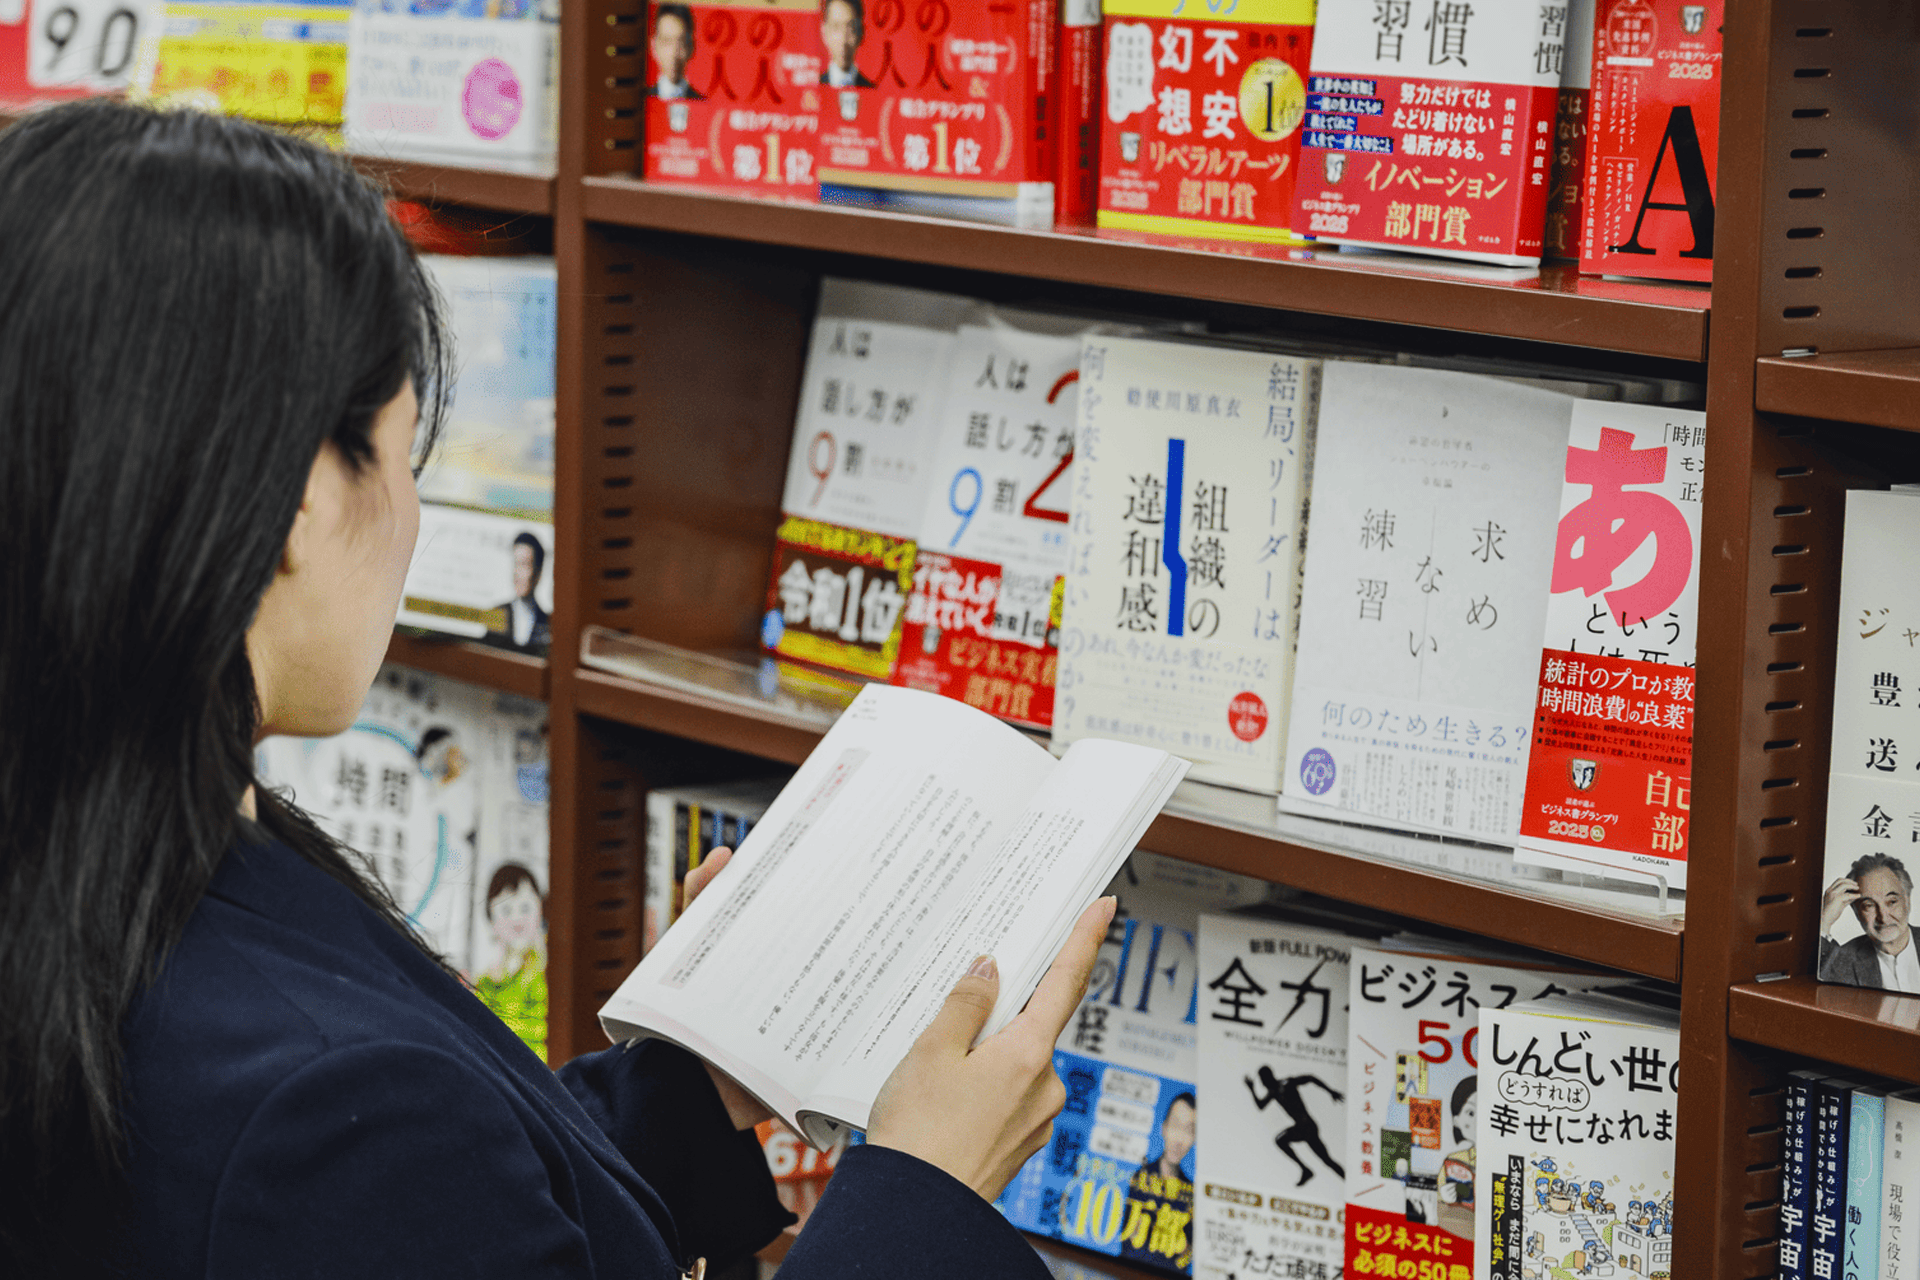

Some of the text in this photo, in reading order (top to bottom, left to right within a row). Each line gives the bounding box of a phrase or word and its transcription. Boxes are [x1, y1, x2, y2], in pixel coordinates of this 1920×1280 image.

[1372, 0, 1475, 67] 習慣
[1532, 6, 1566, 75] 習慣
[1157, 24, 1193, 136] 幻想
[1203, 29, 1240, 140] 不安
[1400, 82, 1491, 109] 努力だけでは
[1392, 107, 1495, 134] たどり着けない
[903, 121, 982, 174] 第1位
[1150, 140, 1290, 181] リベラルアーツ
[1401, 133, 1484, 162] 場所がある。
[1178, 177, 1258, 220] 部門賞
[1364, 160, 1508, 201] イノベーション
[1384, 200, 1471, 246] 部門賞
[975, 353, 1030, 393] 人は
[1253, 361, 1300, 641] 結局、リーダーは
[1550, 426, 1693, 627] あ
[1117, 472, 1166, 633] 違和感
[1187, 480, 1230, 639] 組織の
[1356, 507, 1397, 622] 練習
[1466, 520, 1508, 631] 求め
[1409, 555, 1444, 658] ない
[1586, 603, 1680, 645] という
[1544, 657, 1694, 702] 統計のプロが教
[1322, 699, 1527, 752] 何のため生きる？
[1541, 803, 1619, 825] ビジネス書グランプリ
[1652, 812, 1686, 853] 部
[1632, 855, 1670, 867] KADOKAWA
[1208, 956, 1349, 1040] 全力
[1361, 964, 1568, 1018] ビジネス
[1505, 1077, 1584, 1104] どうすれば
[1490, 1104, 1673, 1145] 幸せになれま
[1509, 1157, 1523, 1211] いまなら
[1355, 1221, 1453, 1257] ビジネスに
[1813, 1213, 1837, 1280] 宇宙
[1886, 1183, 1904, 1280] 現場で役立
